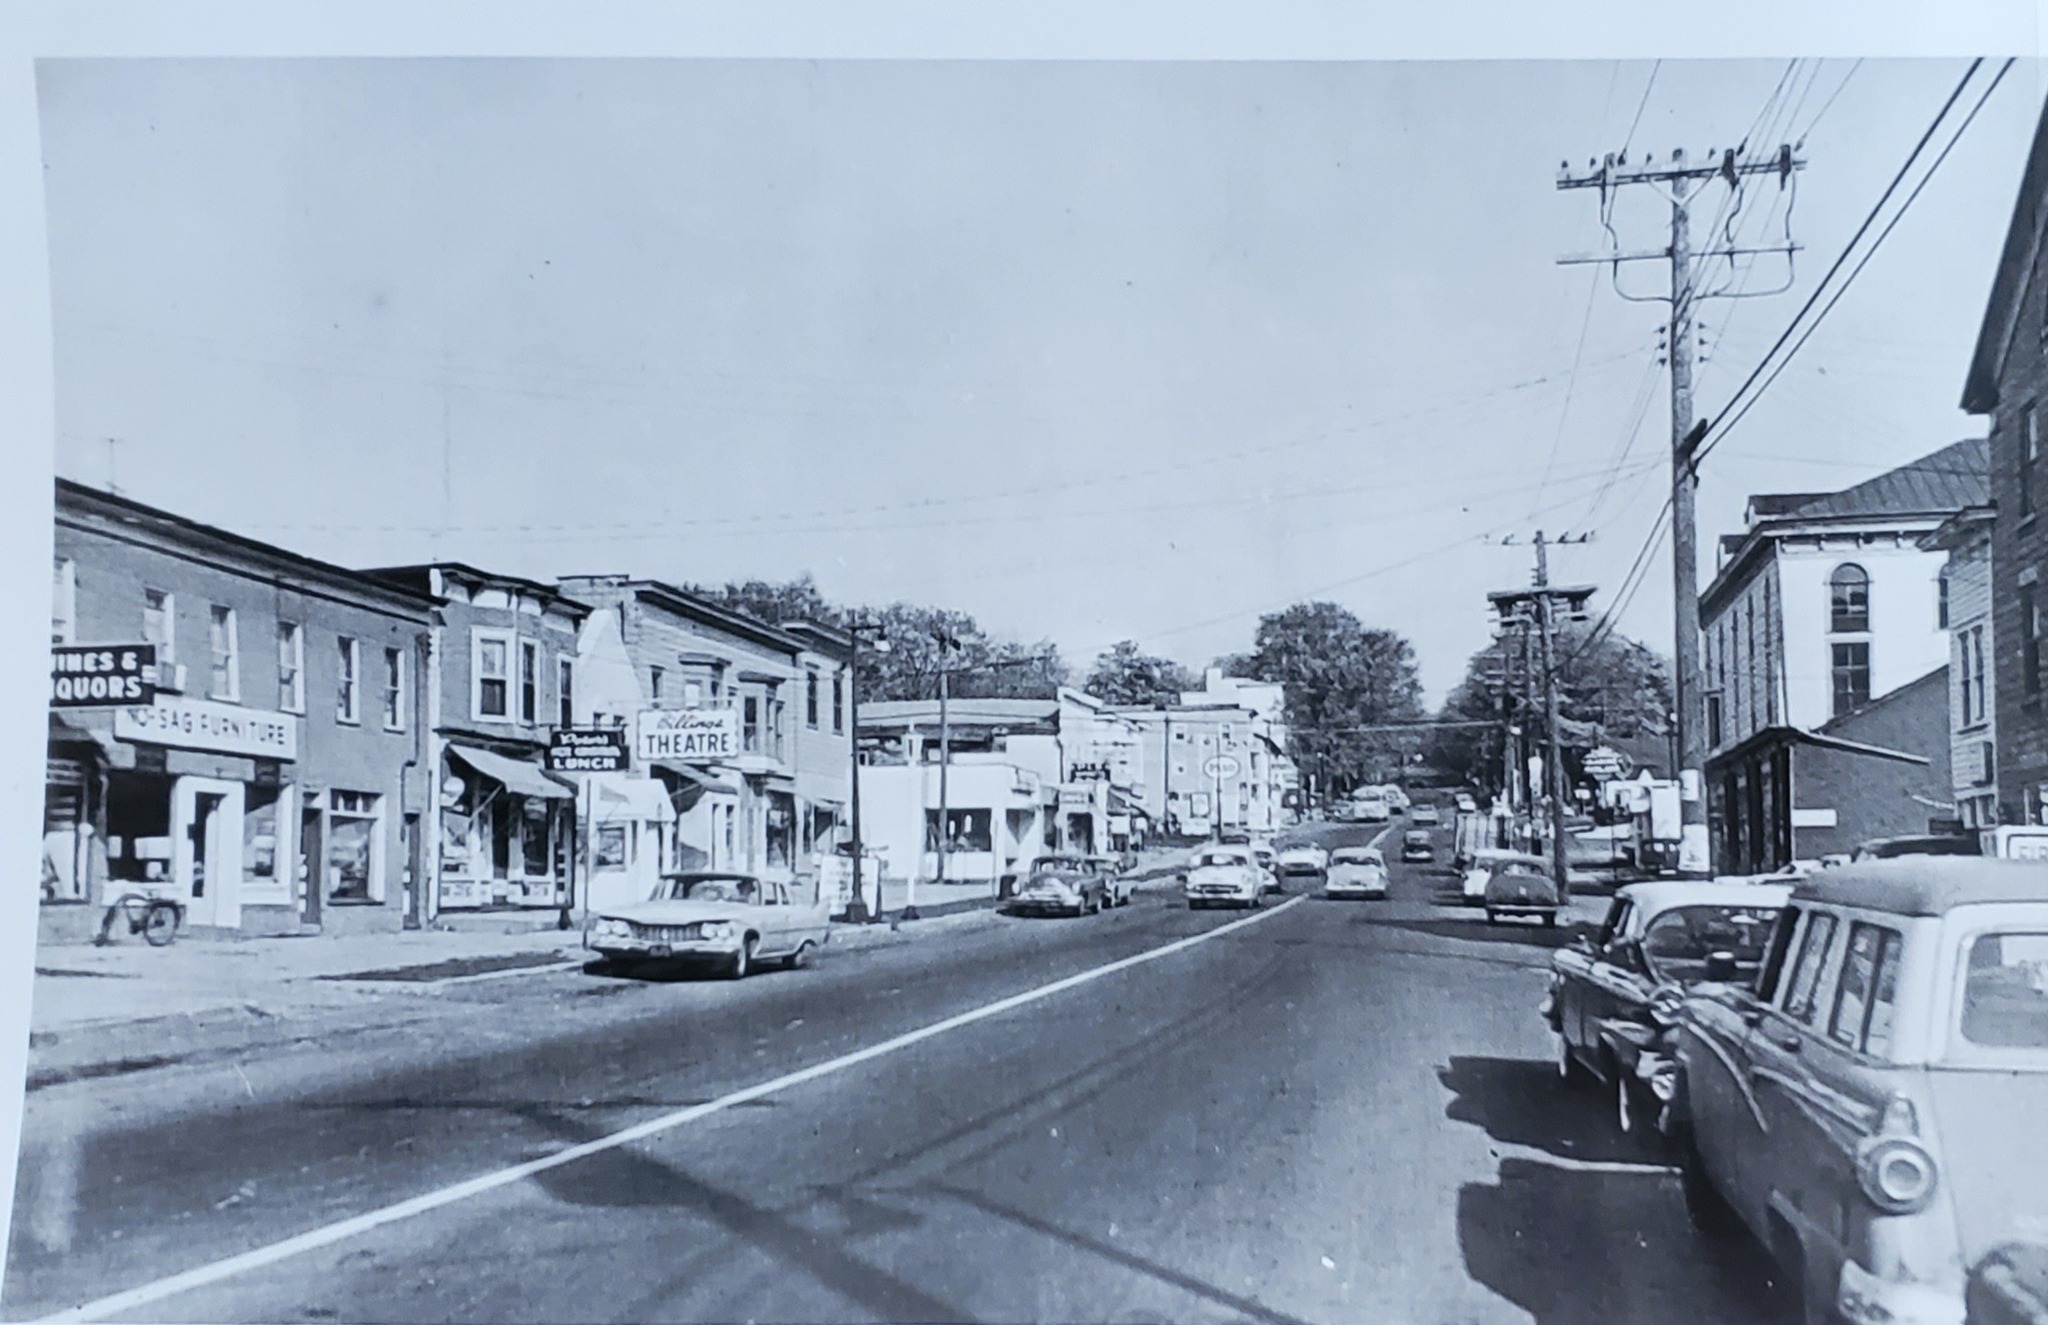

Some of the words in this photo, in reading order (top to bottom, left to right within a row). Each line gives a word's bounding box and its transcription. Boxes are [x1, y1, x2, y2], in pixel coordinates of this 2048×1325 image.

[121, 651, 137, 670] &
[52, 675, 142, 700] QUORS
[646, 733, 729, 754] THEATRE
[554, 757, 615, 769] LUNCH
